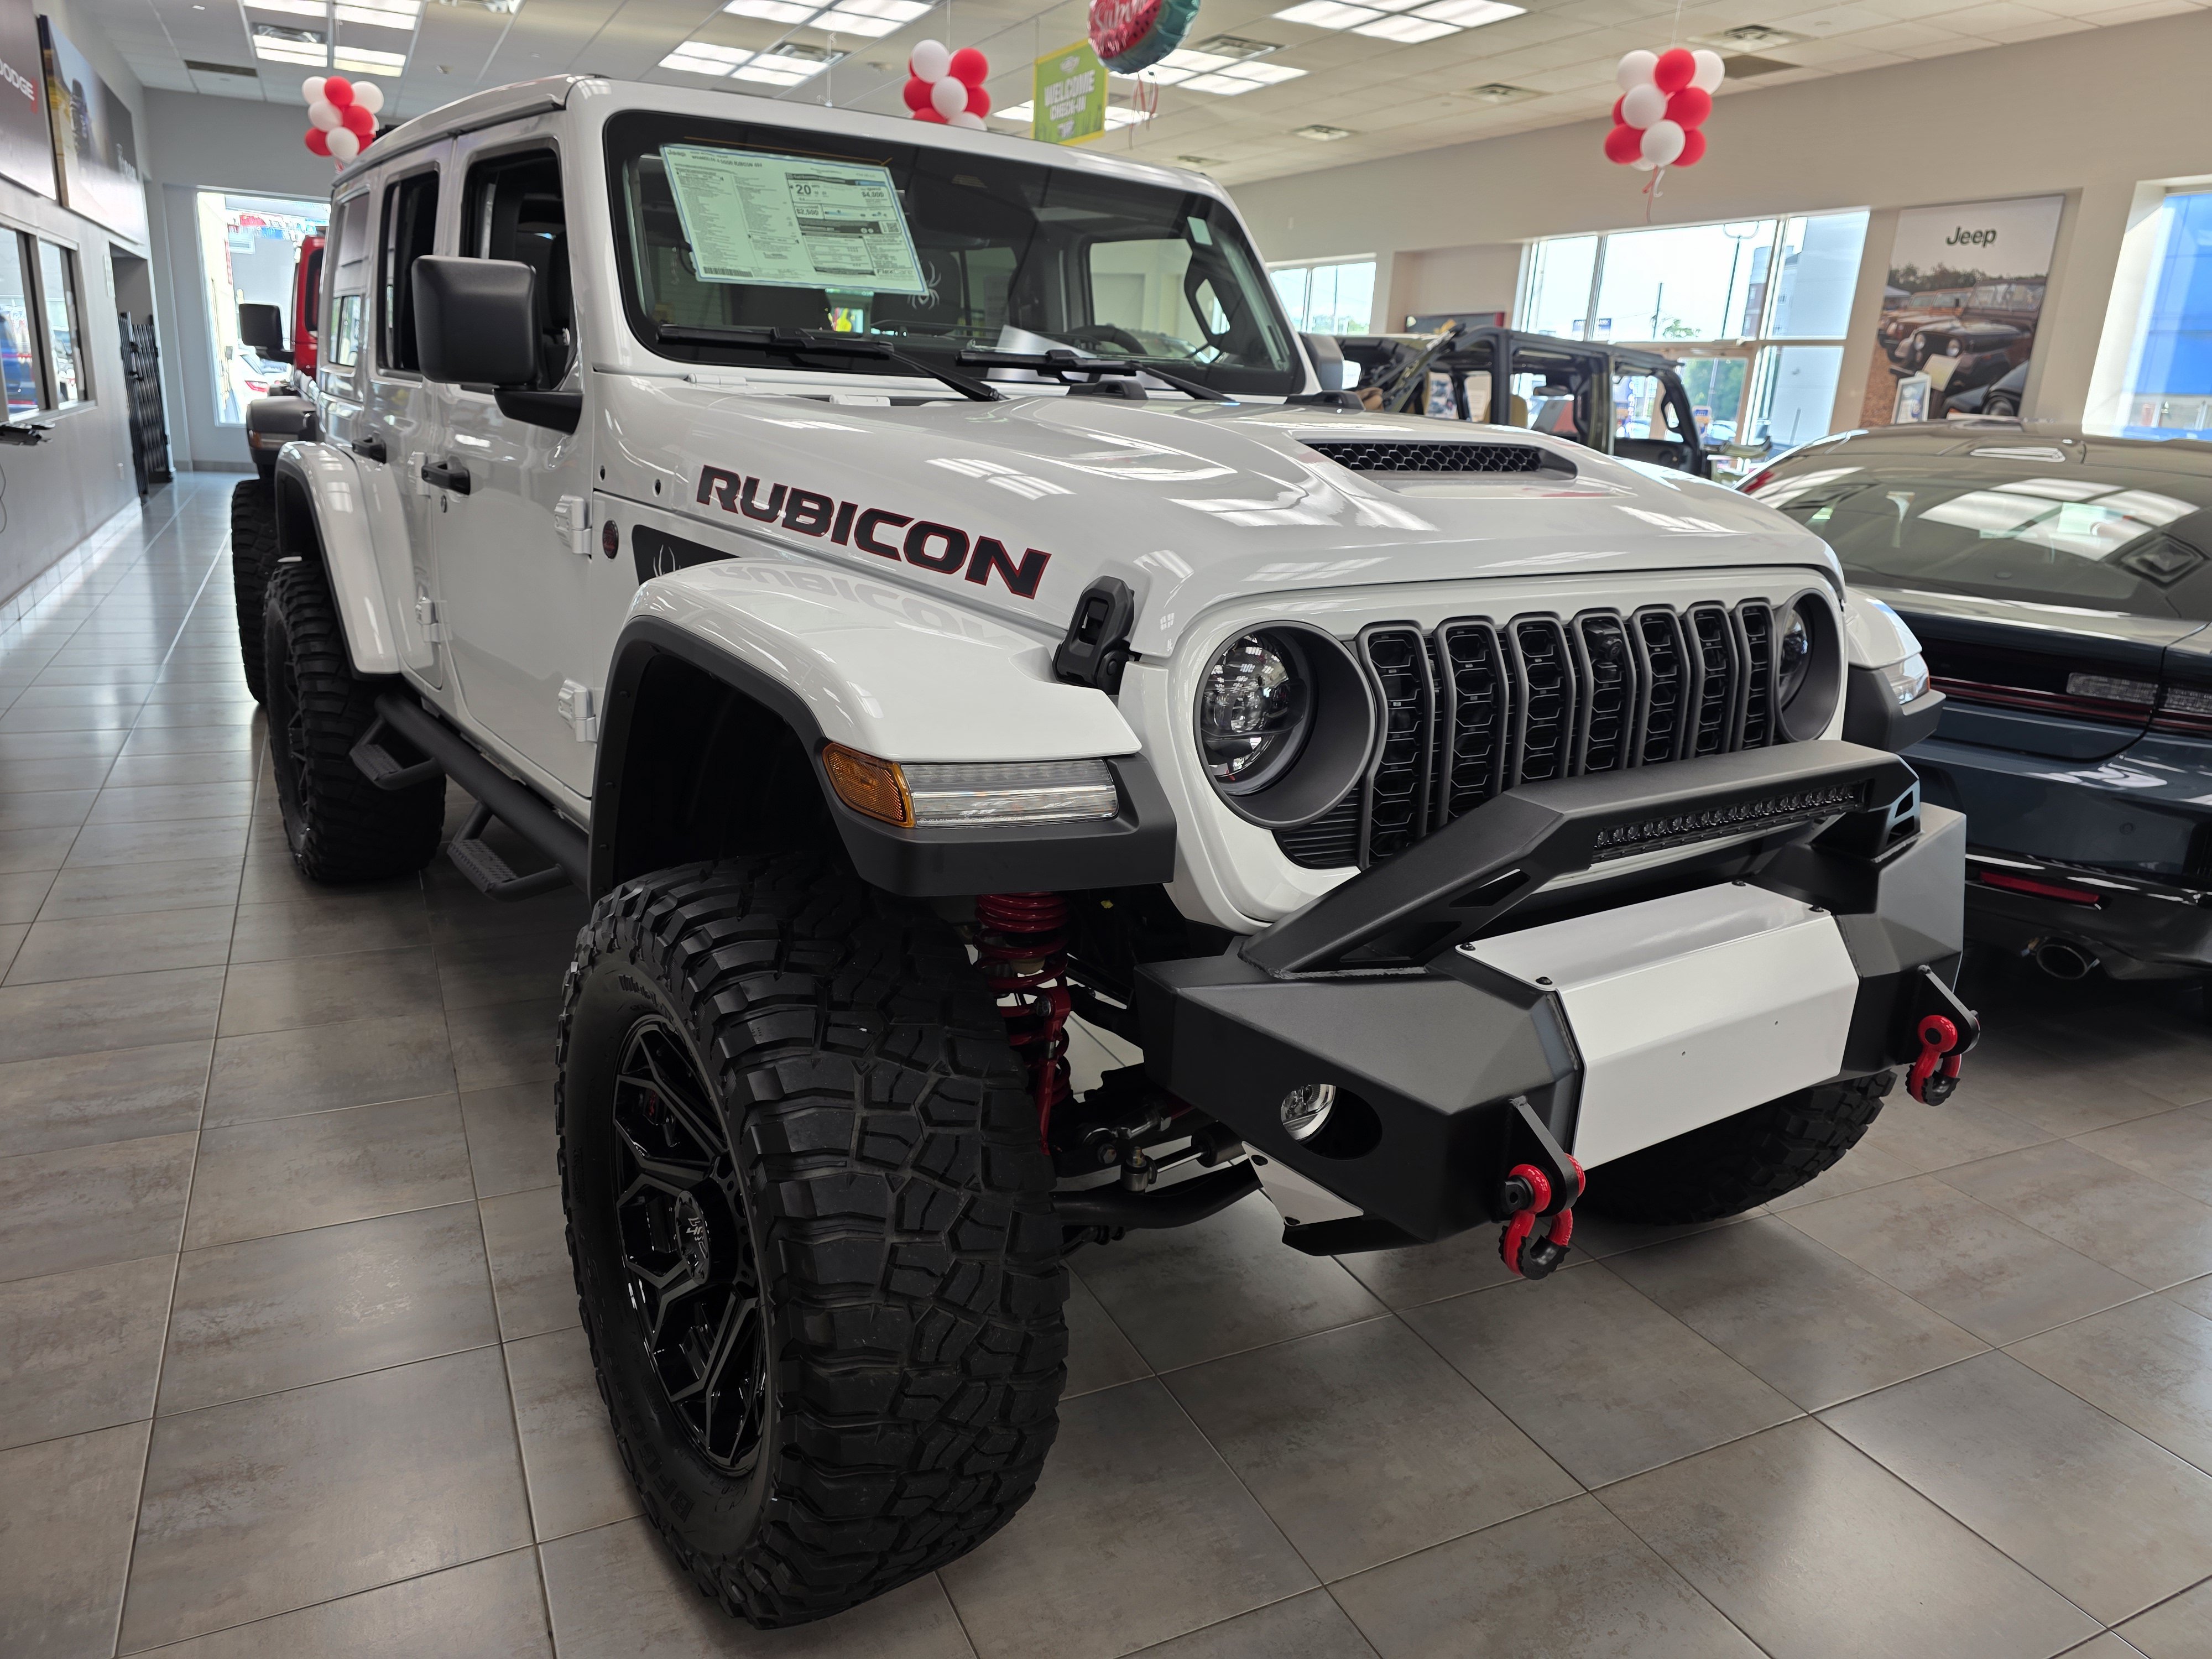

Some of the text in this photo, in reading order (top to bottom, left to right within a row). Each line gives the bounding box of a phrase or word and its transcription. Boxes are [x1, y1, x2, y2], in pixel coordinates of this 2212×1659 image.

[1044, 69, 1095, 107] WELCOME
[1050, 97, 1087, 121] CHECK-IN
[796, 184, 812, 195] 20
[1945, 226, 1997, 248] Jeep
[696, 464, 1052, 599] RUBICON
